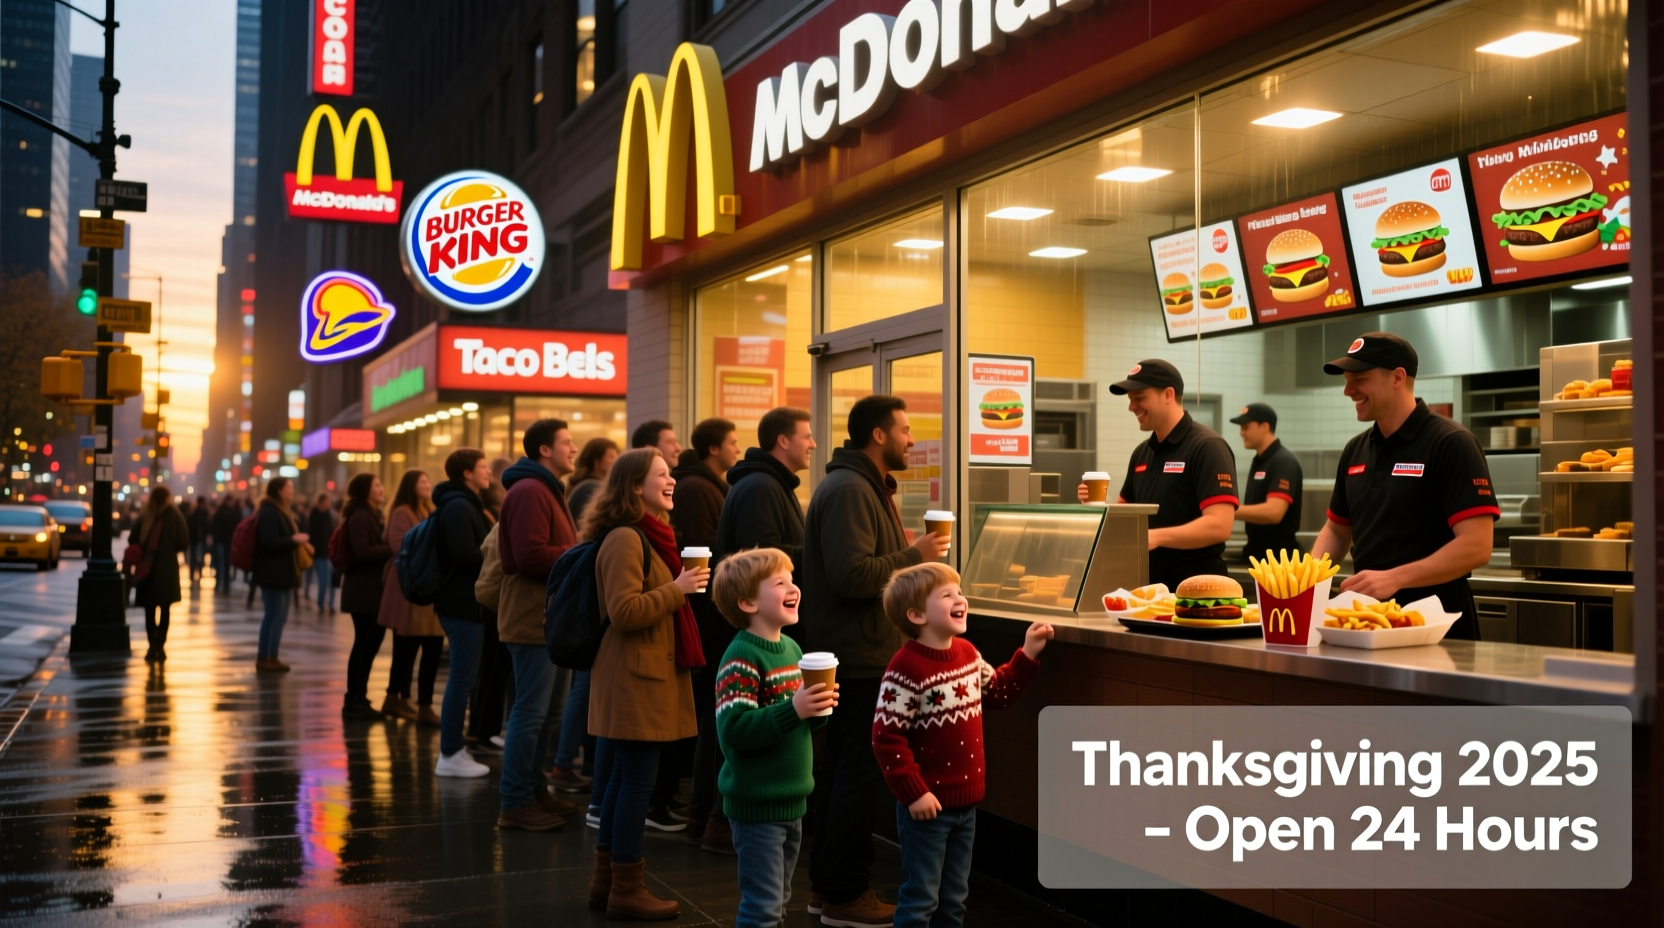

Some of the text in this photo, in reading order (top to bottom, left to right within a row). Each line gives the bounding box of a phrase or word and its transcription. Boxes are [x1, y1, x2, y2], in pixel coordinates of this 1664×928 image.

[292, 189, 396, 213] McDonald's
[426, 201, 525, 242] BURGER
[428, 223, 528, 274] KING
[453, 338, 616, 381] Taco Bels
